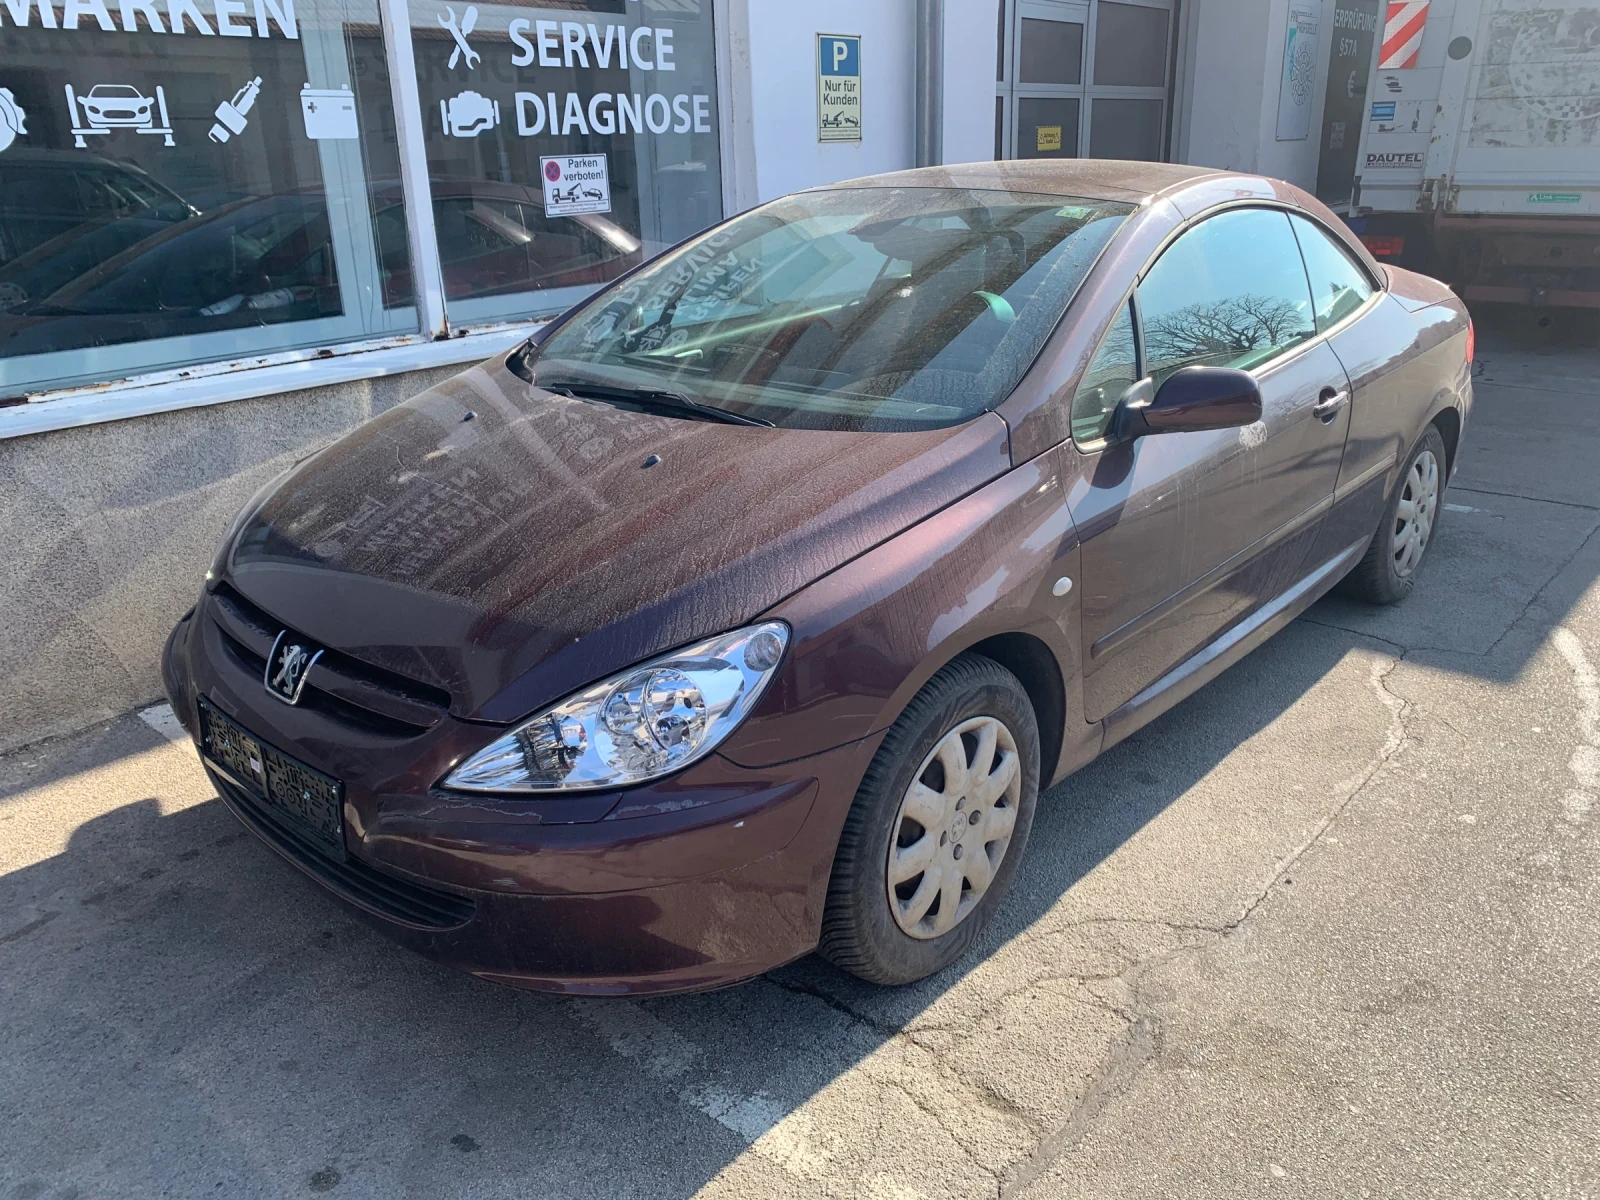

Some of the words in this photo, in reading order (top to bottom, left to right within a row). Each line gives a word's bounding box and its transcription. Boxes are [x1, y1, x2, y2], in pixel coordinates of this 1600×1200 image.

[509, 18, 676, 71] SERVICE
[833, 41, 848, 71] P
[825, 80, 841, 92] Nur
[844, 80, 856, 92] für
[823, 93, 858, 105] Kunden
[514, 92, 711, 136] DIAGNOSE
[568, 158, 598, 168] Parken
[1366, 153, 1422, 162] DAUTEL
[563, 169, 604, 181] verboten!
